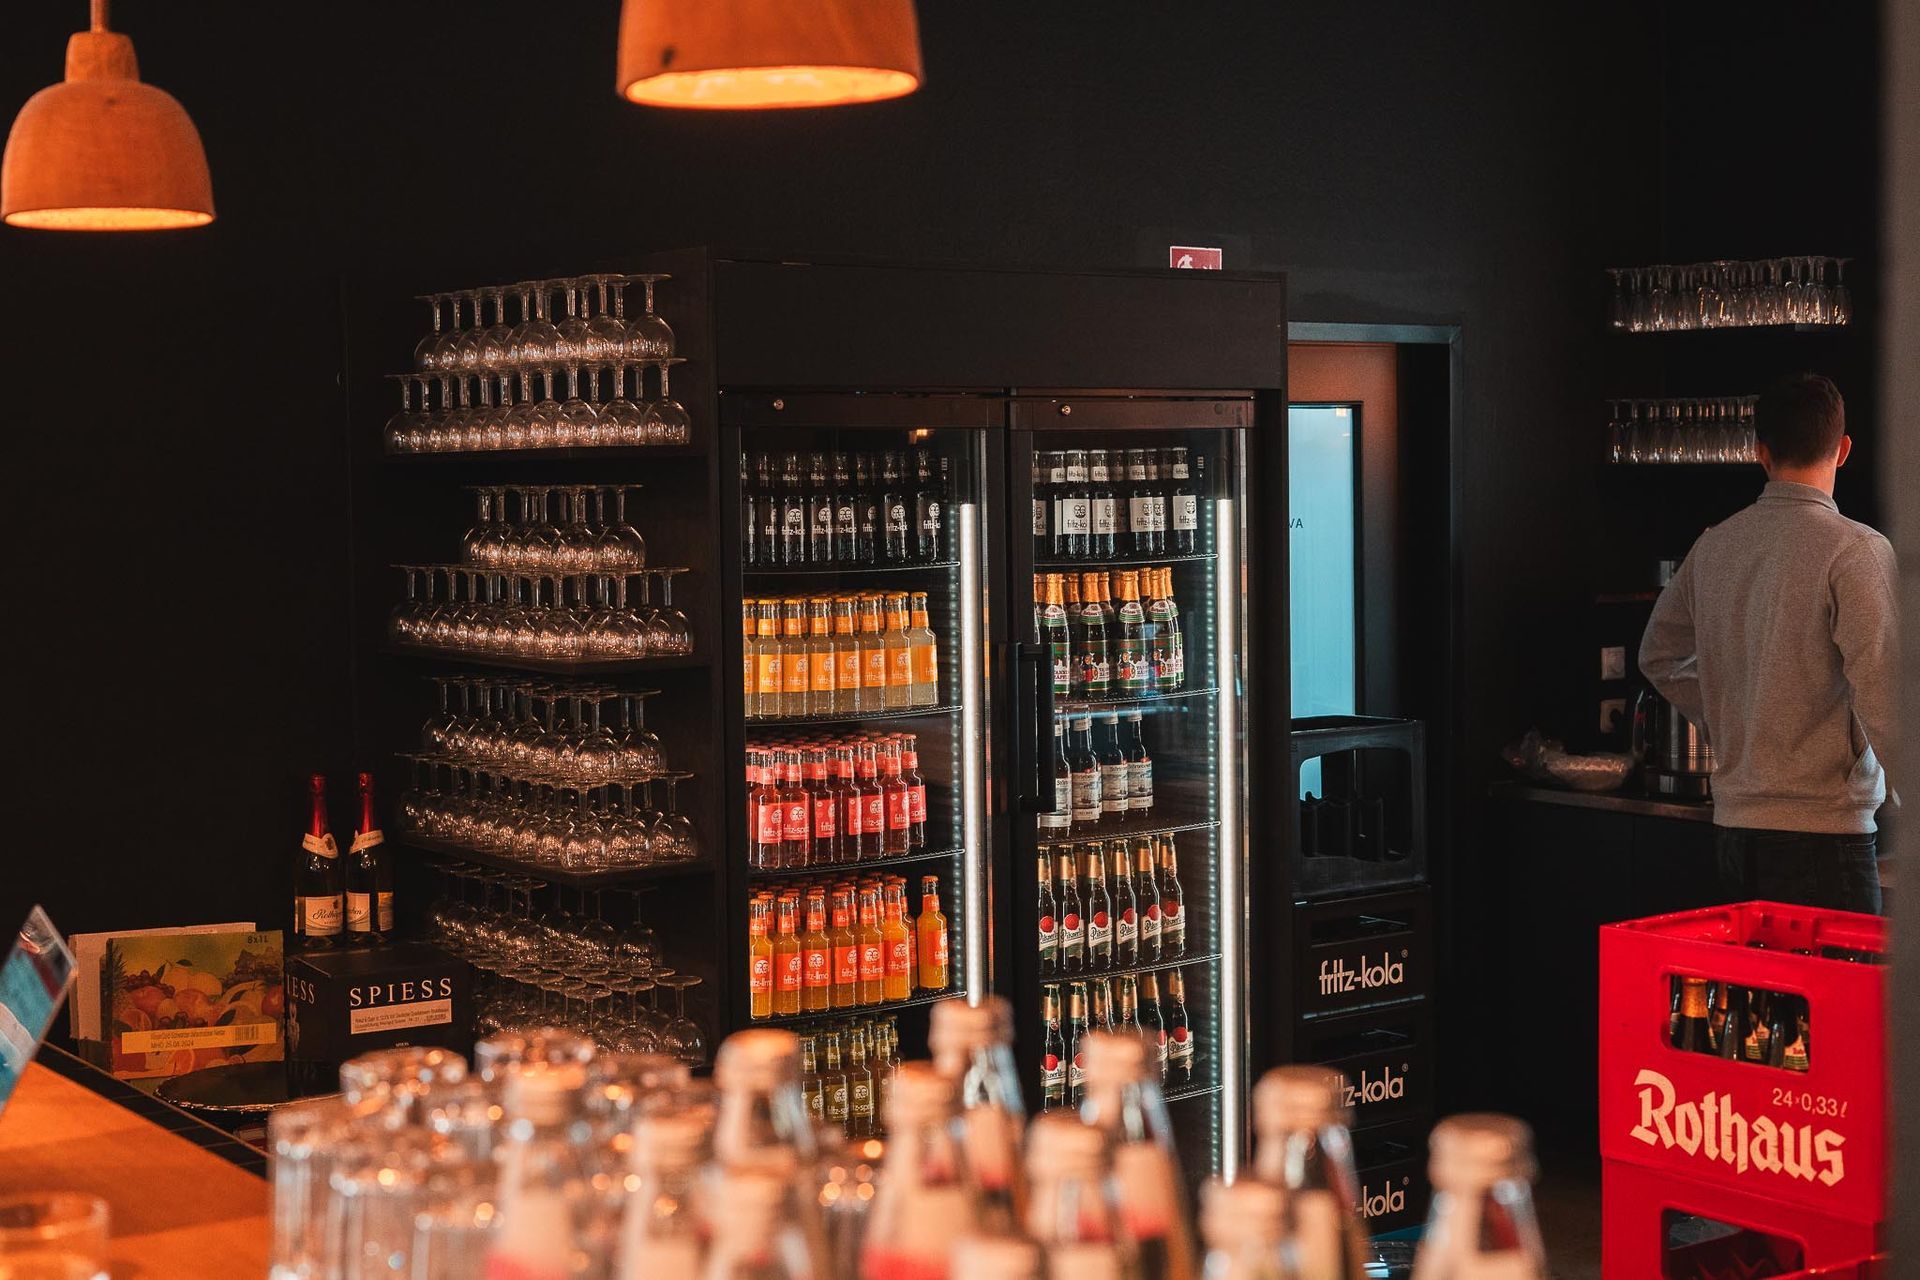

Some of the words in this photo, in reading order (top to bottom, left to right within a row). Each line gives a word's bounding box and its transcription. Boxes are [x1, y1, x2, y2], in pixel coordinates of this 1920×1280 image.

[350, 977, 452, 1008] SPIESS
[1319, 952, 1403, 995] fritz-kola
[1629, 1068, 1846, 1187] Rothaus
